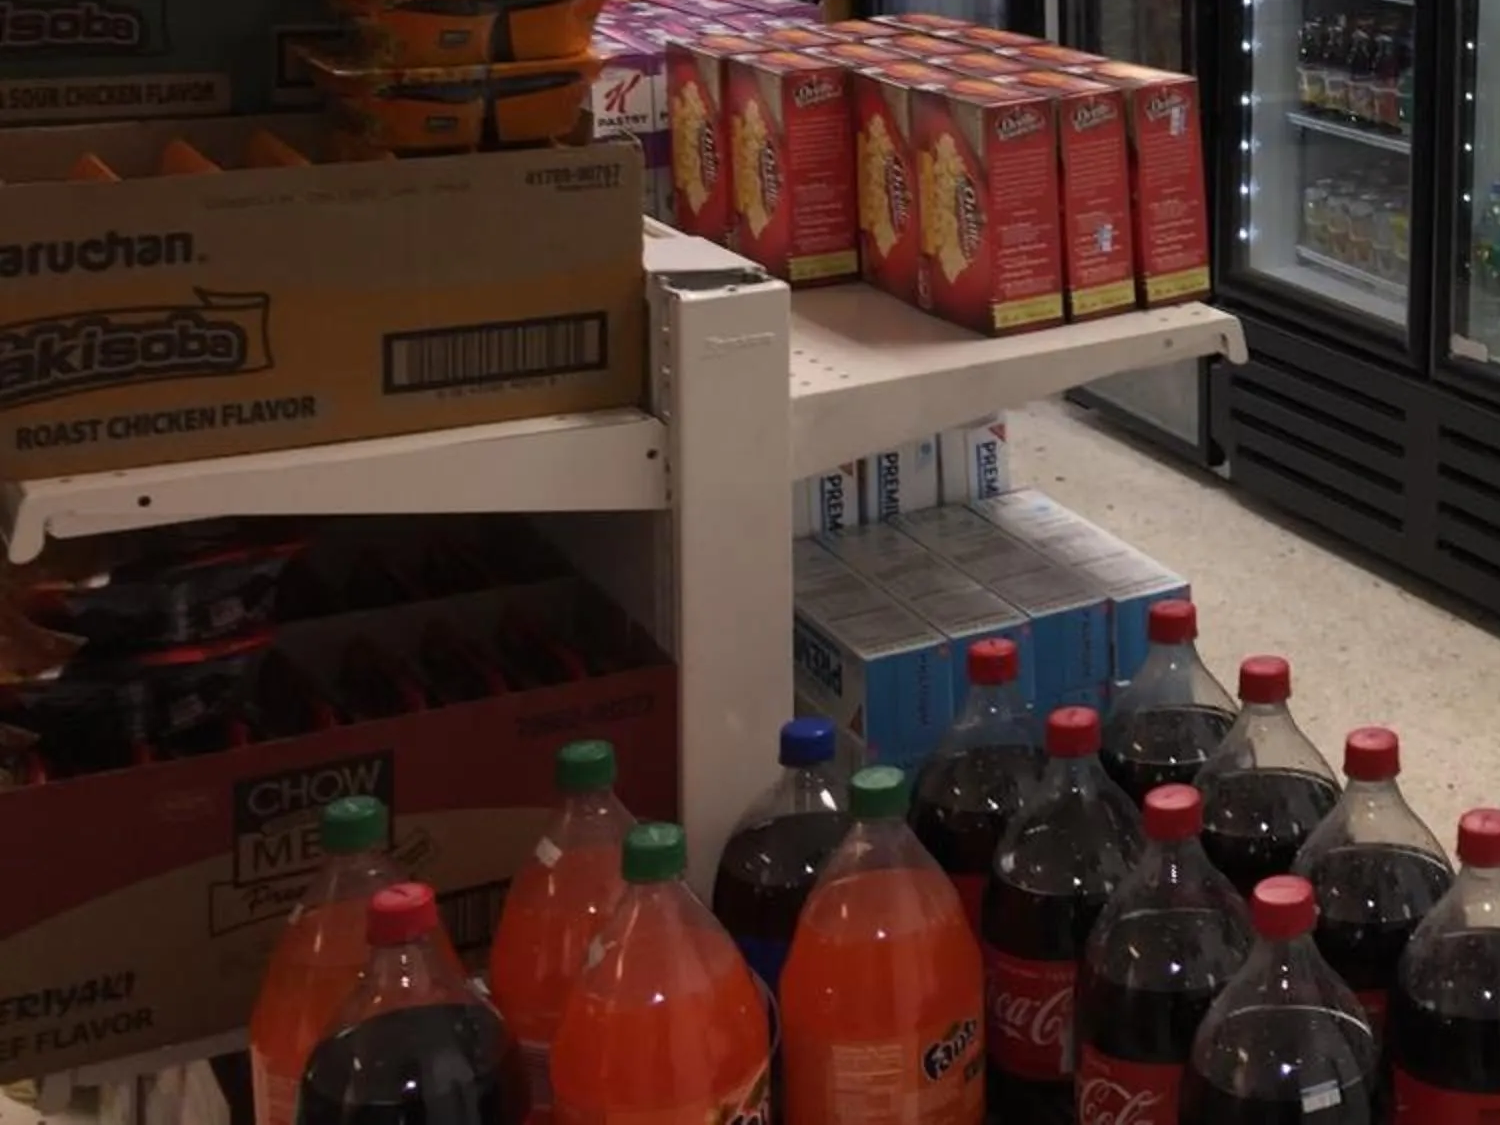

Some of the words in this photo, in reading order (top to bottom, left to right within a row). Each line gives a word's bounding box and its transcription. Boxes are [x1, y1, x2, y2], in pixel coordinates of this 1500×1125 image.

[0, 230, 193, 277] aruchan
[0, 325, 239, 387] akisoba
[16, 419, 104, 451] ROAST
[106, 407, 217, 441] CHICKEN
[221, 395, 316, 428] FLAVOR
[247, 759, 382, 816] CHOW
[252, 831, 326, 871] ME
[0, 970, 134, 1026] ERIYAKI
[36, 1006, 153, 1053] FLAVOR
